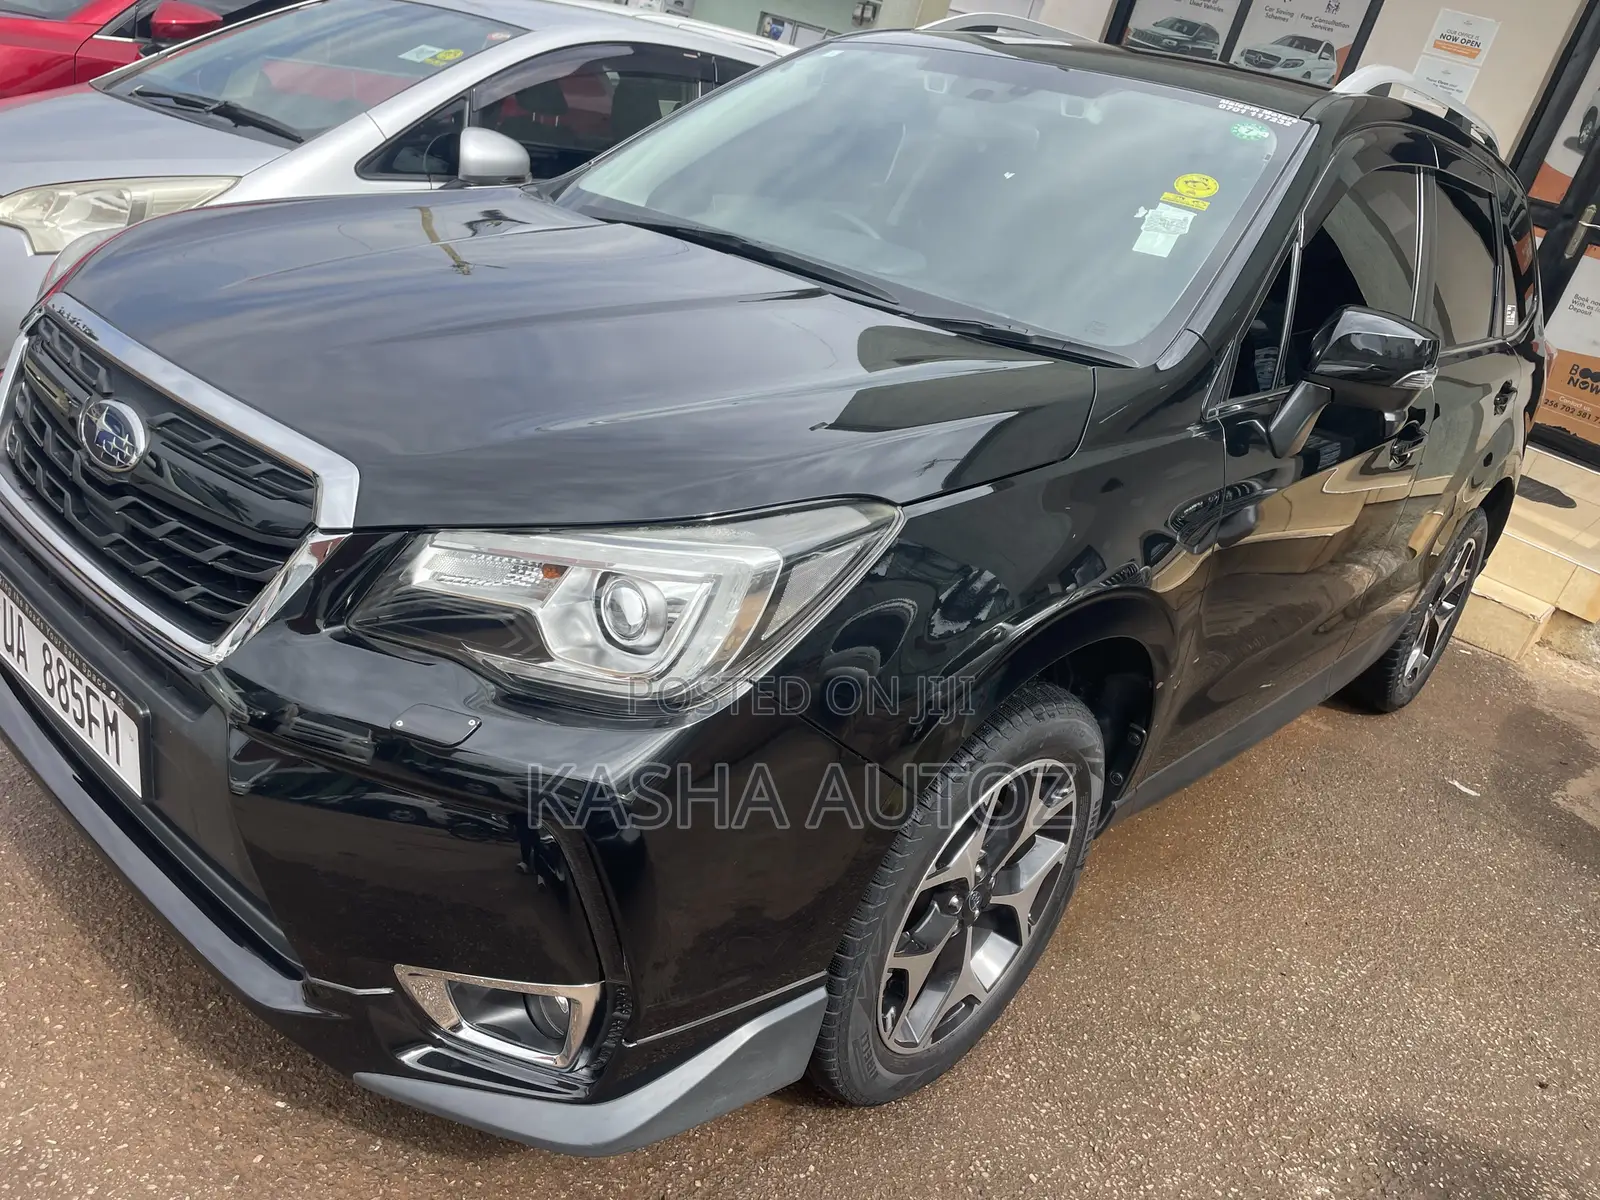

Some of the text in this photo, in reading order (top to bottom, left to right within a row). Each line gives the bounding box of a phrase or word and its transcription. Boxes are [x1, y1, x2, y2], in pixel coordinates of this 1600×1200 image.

[1265, 12, 1289, 23] Schemes
[1276, 8, 1295, 18] Saving
[1300, 13, 1350, 28] Free Consultation
[1310, 22, 1334, 32] Services
[1439, 33, 1481, 48] NOW OPEN
[1457, 31, 1474, 40] OFFICE
[1218, 103, 1247, 115] 0701
[1572, 299, 1586, 307] With
[1574, 293, 1589, 303] Book
[1558, 396, 1583, 408] Contact
[1544, 398, 1558, 408] 256
[1560, 404, 1576, 414] 702
[1577, 410, 1592, 420] 581
[45, 625, 62, 647] Your
[82, 662, 107, 691] Space
[3, 597, 122, 768] UA 885FM
